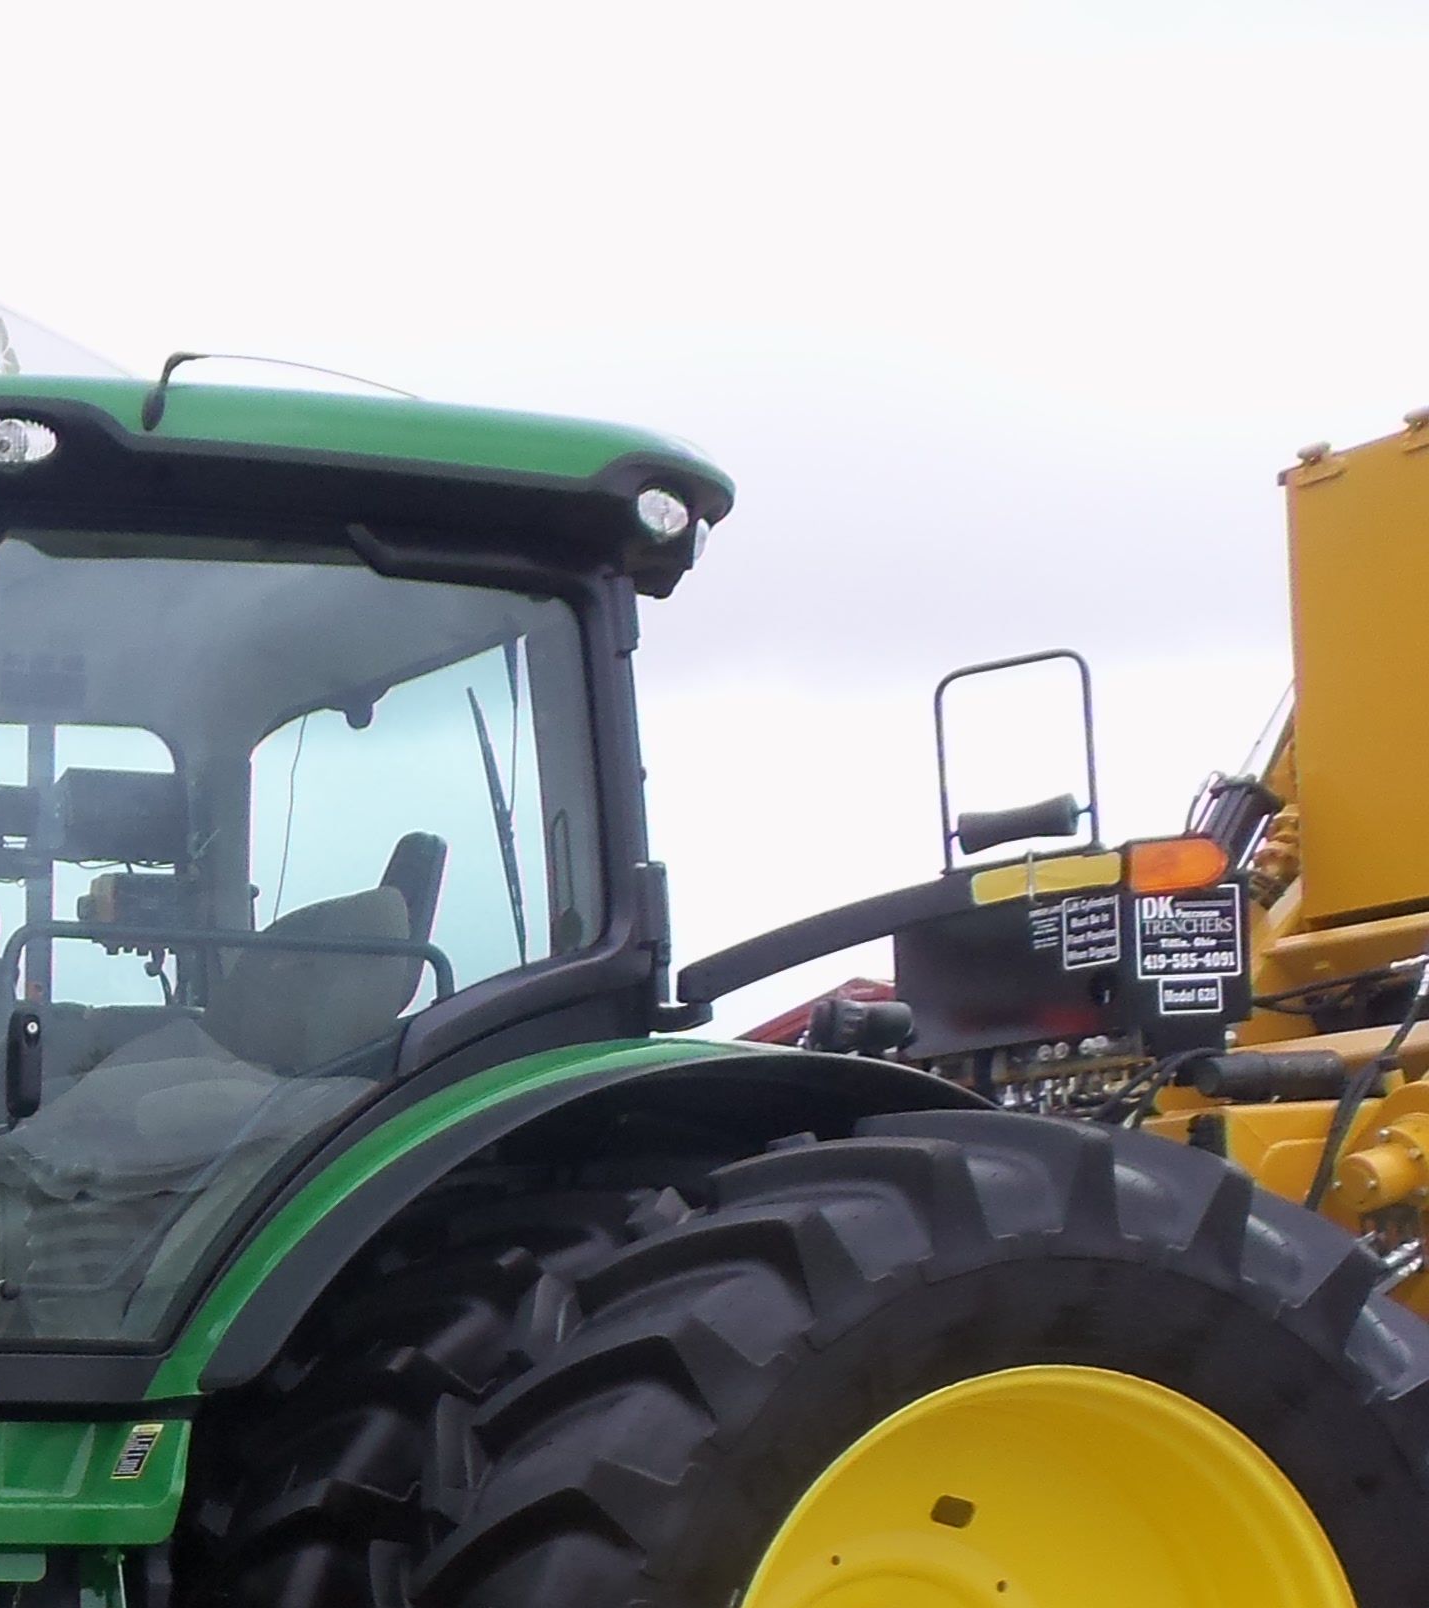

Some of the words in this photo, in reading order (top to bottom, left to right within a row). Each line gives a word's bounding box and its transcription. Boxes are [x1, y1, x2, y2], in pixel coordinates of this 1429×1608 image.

[1142, 895, 1175, 919] DK
[1142, 917, 1233, 935] TRENCHERS
[1193, 936, 1217, 947] Ohio
[1143, 951, 1236, 970] 419-585-4091
[1164, 988, 1195, 1002] Model
